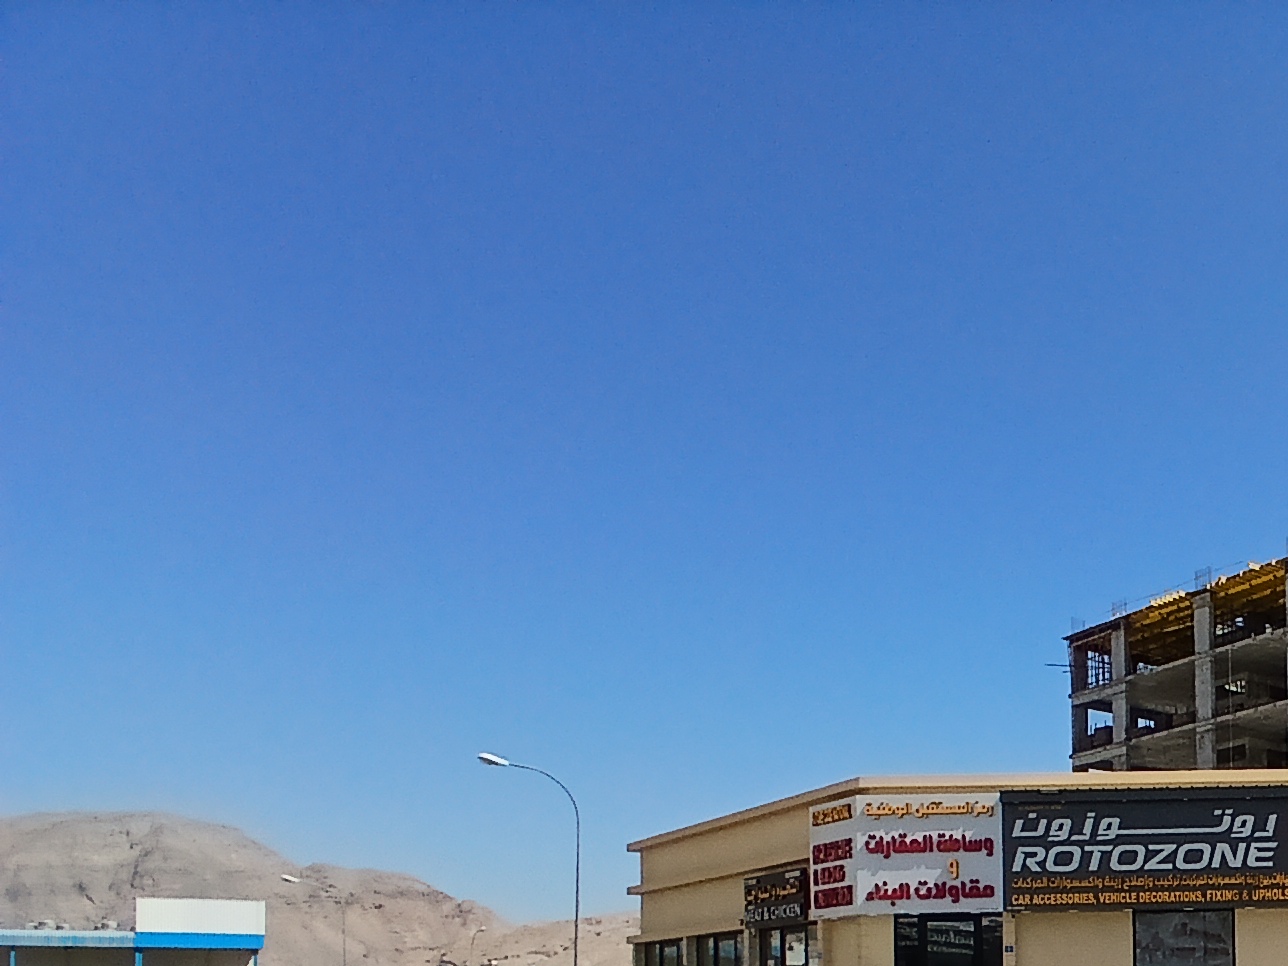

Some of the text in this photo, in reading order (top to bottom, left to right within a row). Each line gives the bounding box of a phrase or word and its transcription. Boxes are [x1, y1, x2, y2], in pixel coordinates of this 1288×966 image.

[864, 802, 912, 820] الوطنية
[914, 801, 972, 819] المستقبل
[972, 801, 995, 818] رمز
[865, 833, 934, 859] العقارات
[936, 833, 995, 857] وساطة
[948, 858, 959, 880] و
[1012, 842, 1279, 873] ROTOZONE
[865, 881, 912, 907] البناء
[914, 879, 995, 903] مقاولات
[1012, 893, 1031, 905] CAR
[1032, 892, 1097, 906] ACCESSORIES,
[1098, 892, 1137, 904] VEHICLE
[1139, 890, 1205, 903] DECORATIONS,
[1206, 889, 1240, 902] FIXING
[1242, 889, 1249, 900] &
